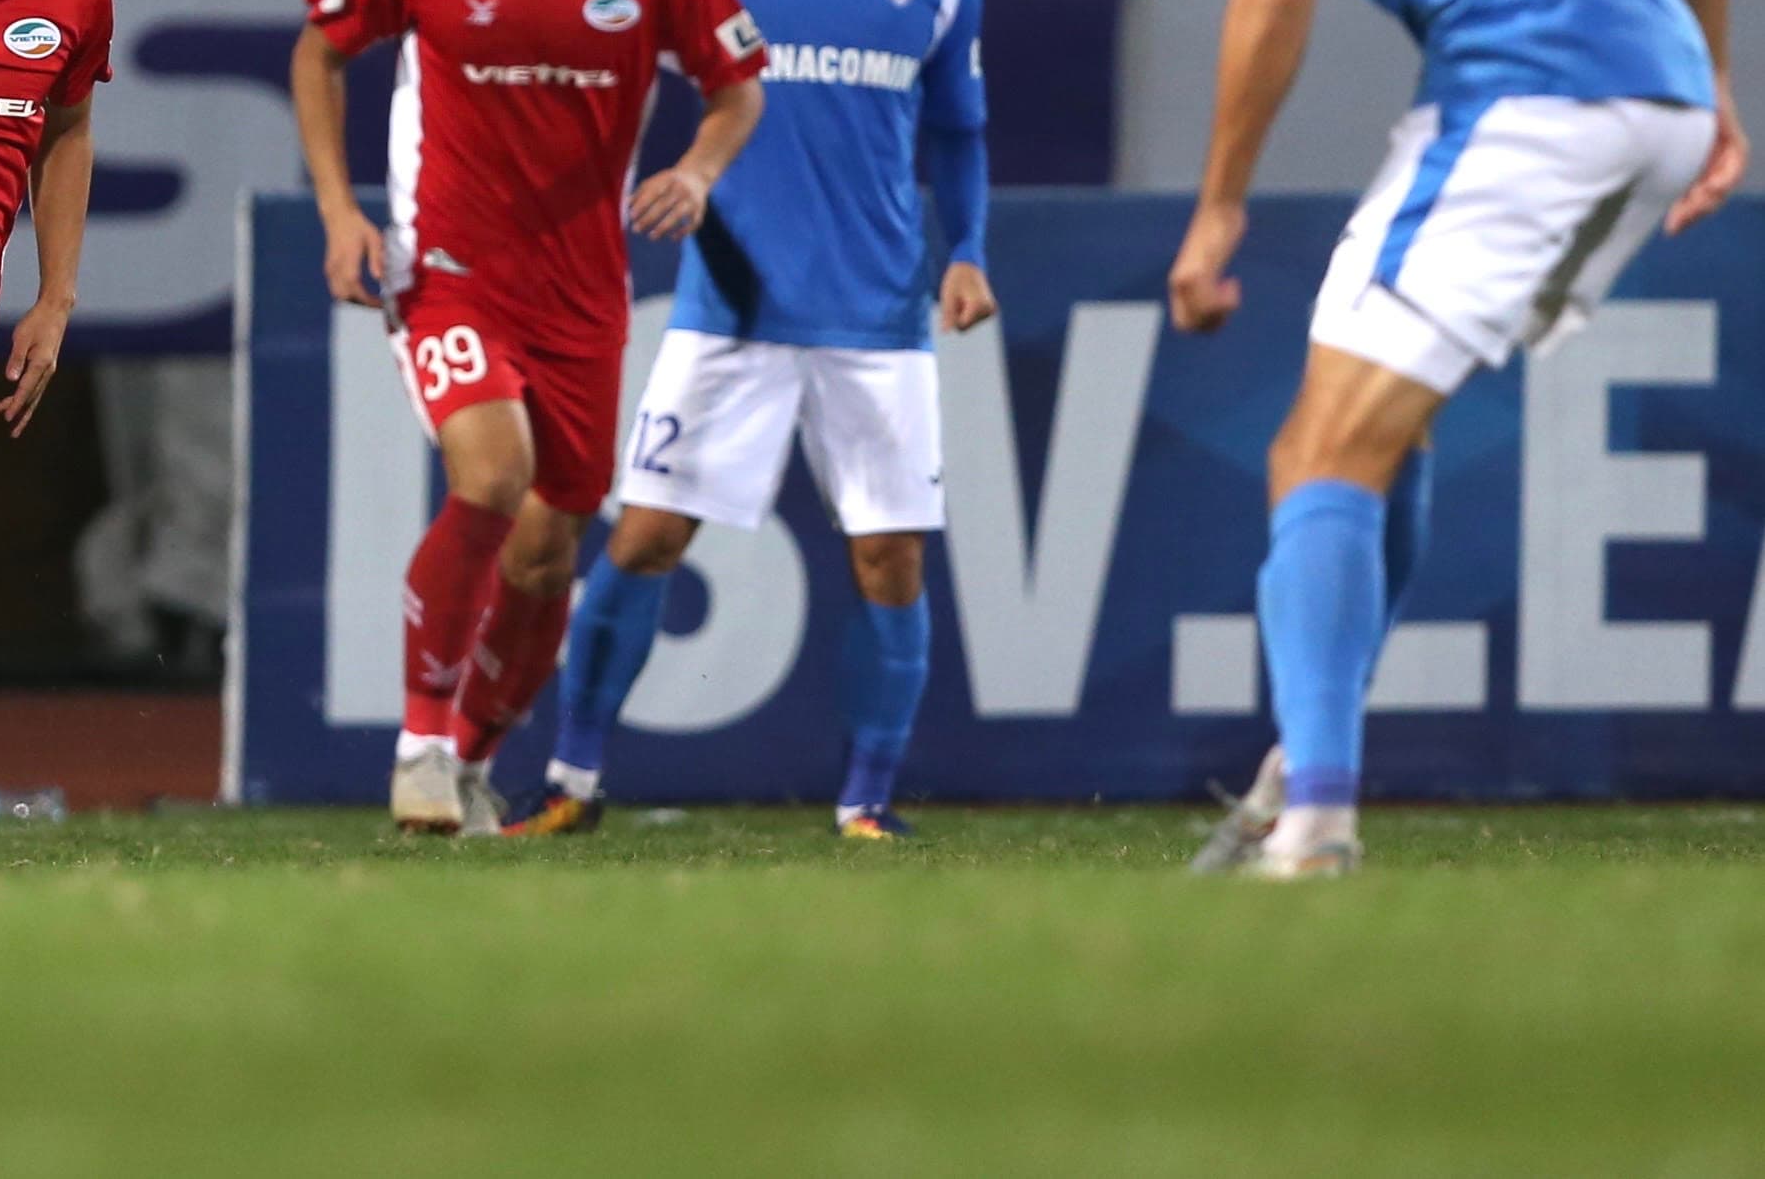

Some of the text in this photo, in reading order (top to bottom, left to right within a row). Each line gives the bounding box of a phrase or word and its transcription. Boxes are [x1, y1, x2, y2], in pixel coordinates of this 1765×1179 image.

[10, 33, 57, 43] VIETTEL
[462, 62, 618, 88] VIETTEL
[416, 324, 488, 402] 39
[633, 412, 680, 474] 12
